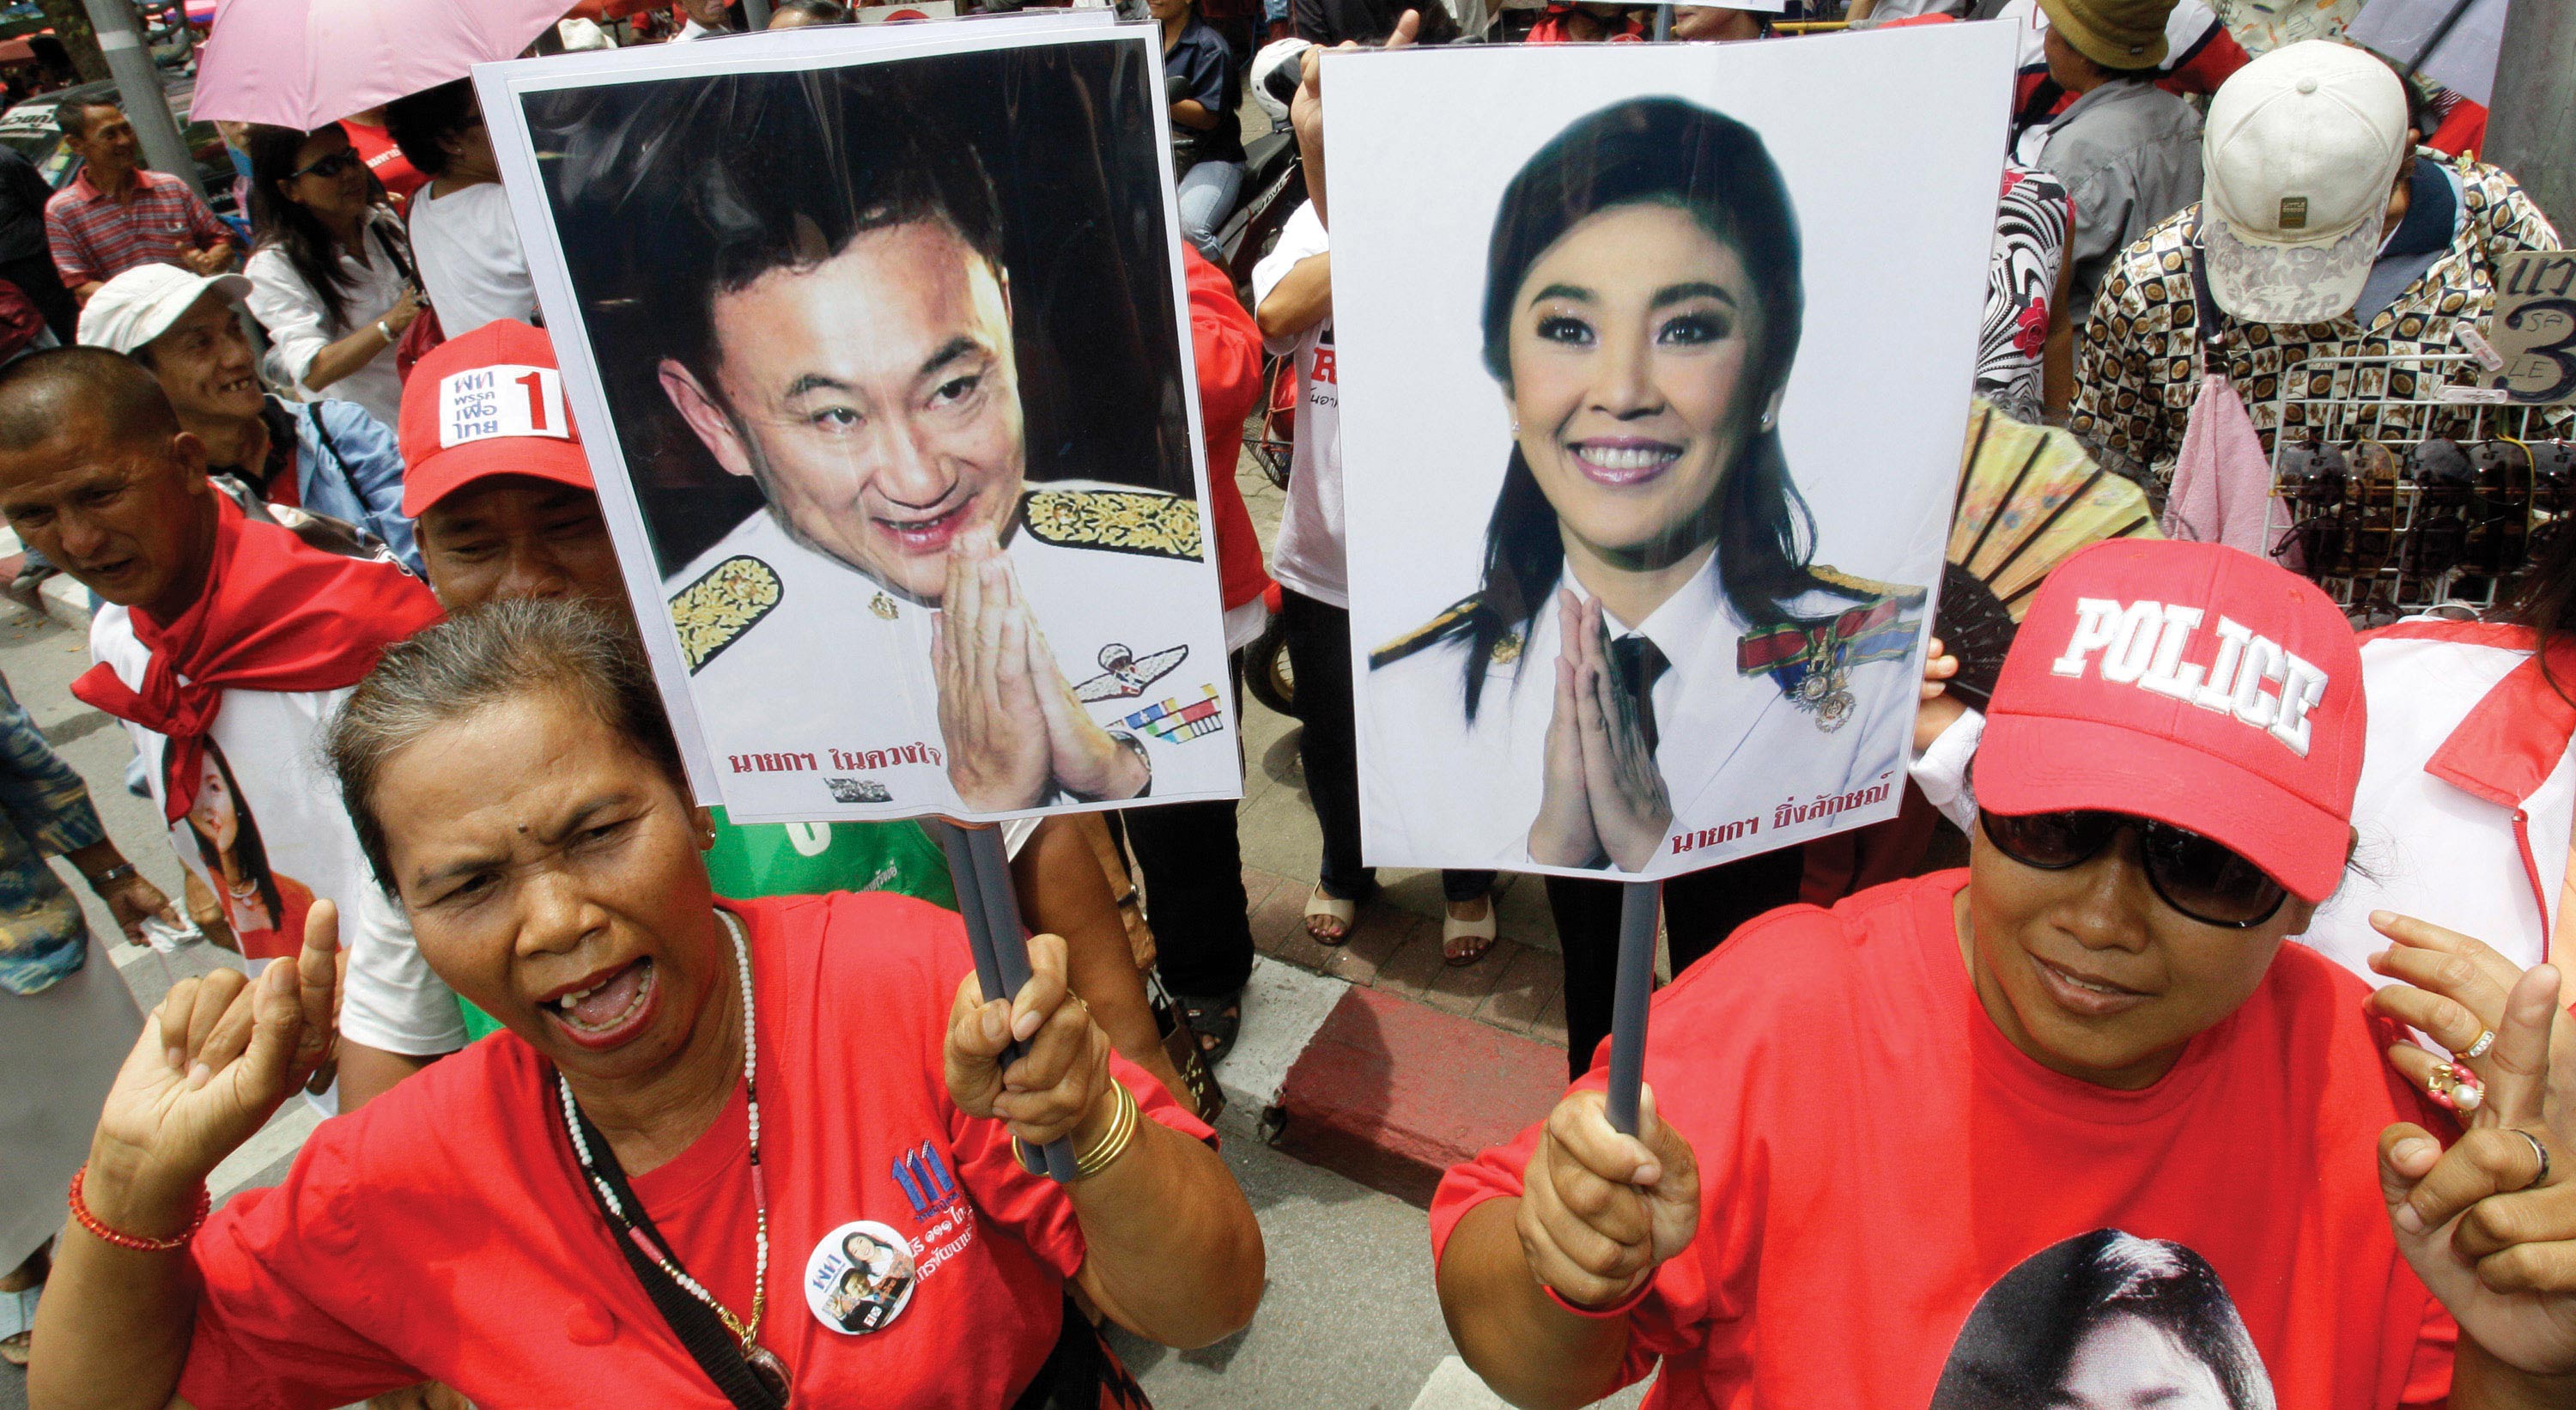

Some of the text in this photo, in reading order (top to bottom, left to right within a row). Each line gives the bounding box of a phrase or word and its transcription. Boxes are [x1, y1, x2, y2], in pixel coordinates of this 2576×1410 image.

[454, 391, 495, 406] พรรค
[515, 371, 547, 430] 1
[456, 399, 498, 422] เพื่อ
[453, 420, 499, 440] ไทย
[2050, 598, 2329, 759] POLICE
[728, 751, 818, 774] นายกฯ
[1671, 770, 1894, 855] นายกฯ ยิ่งลักษณ์
